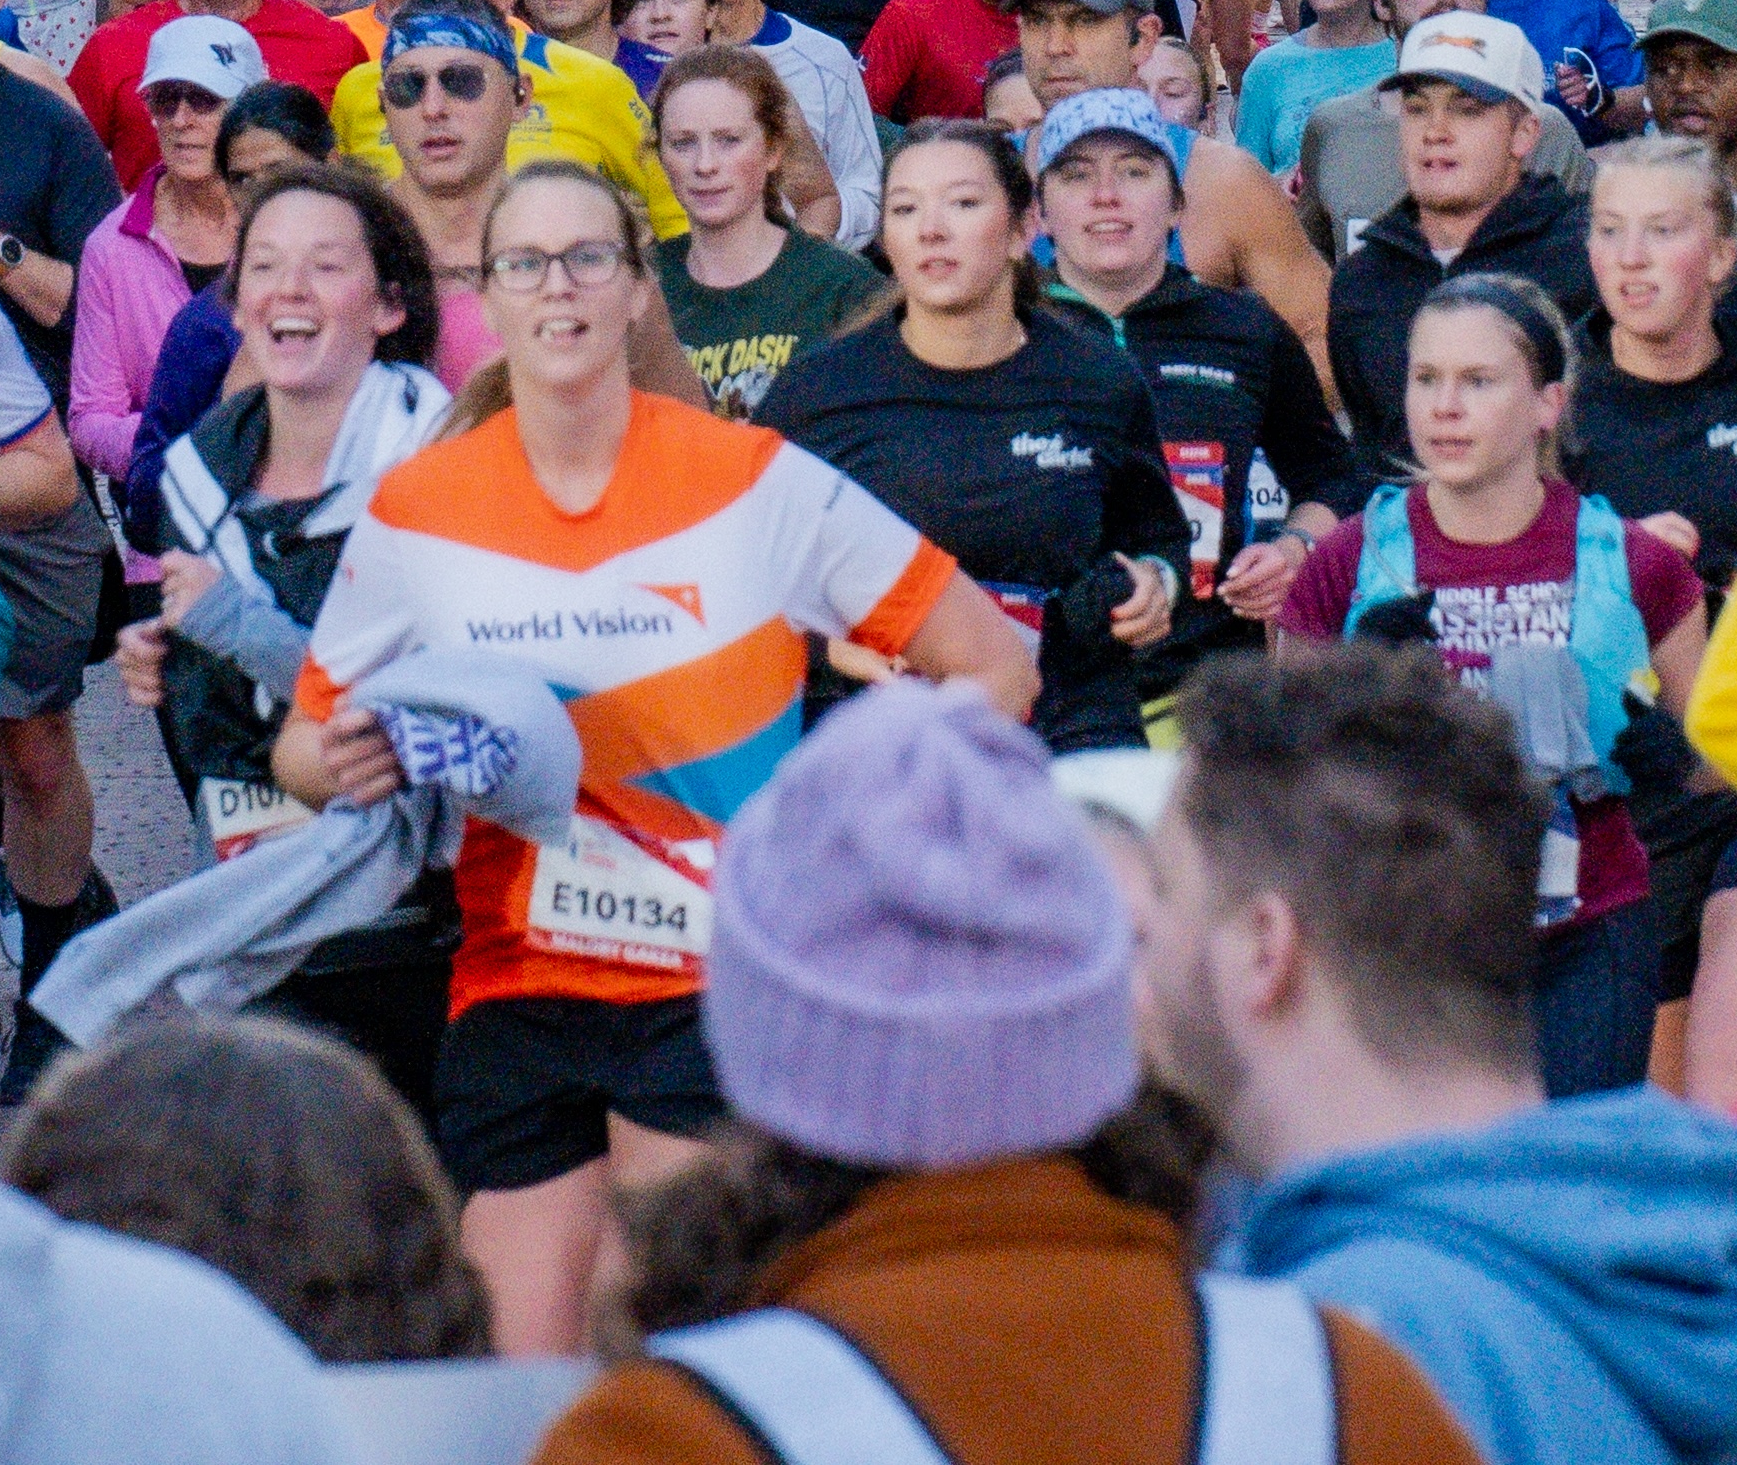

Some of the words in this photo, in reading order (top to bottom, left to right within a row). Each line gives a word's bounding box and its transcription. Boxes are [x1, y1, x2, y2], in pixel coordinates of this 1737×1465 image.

[464, 610, 564, 642] World
[572, 606, 674, 637] Vision
[1428, 601, 1571, 635] ASSISTAN
[551, 881, 688, 933] E10134
